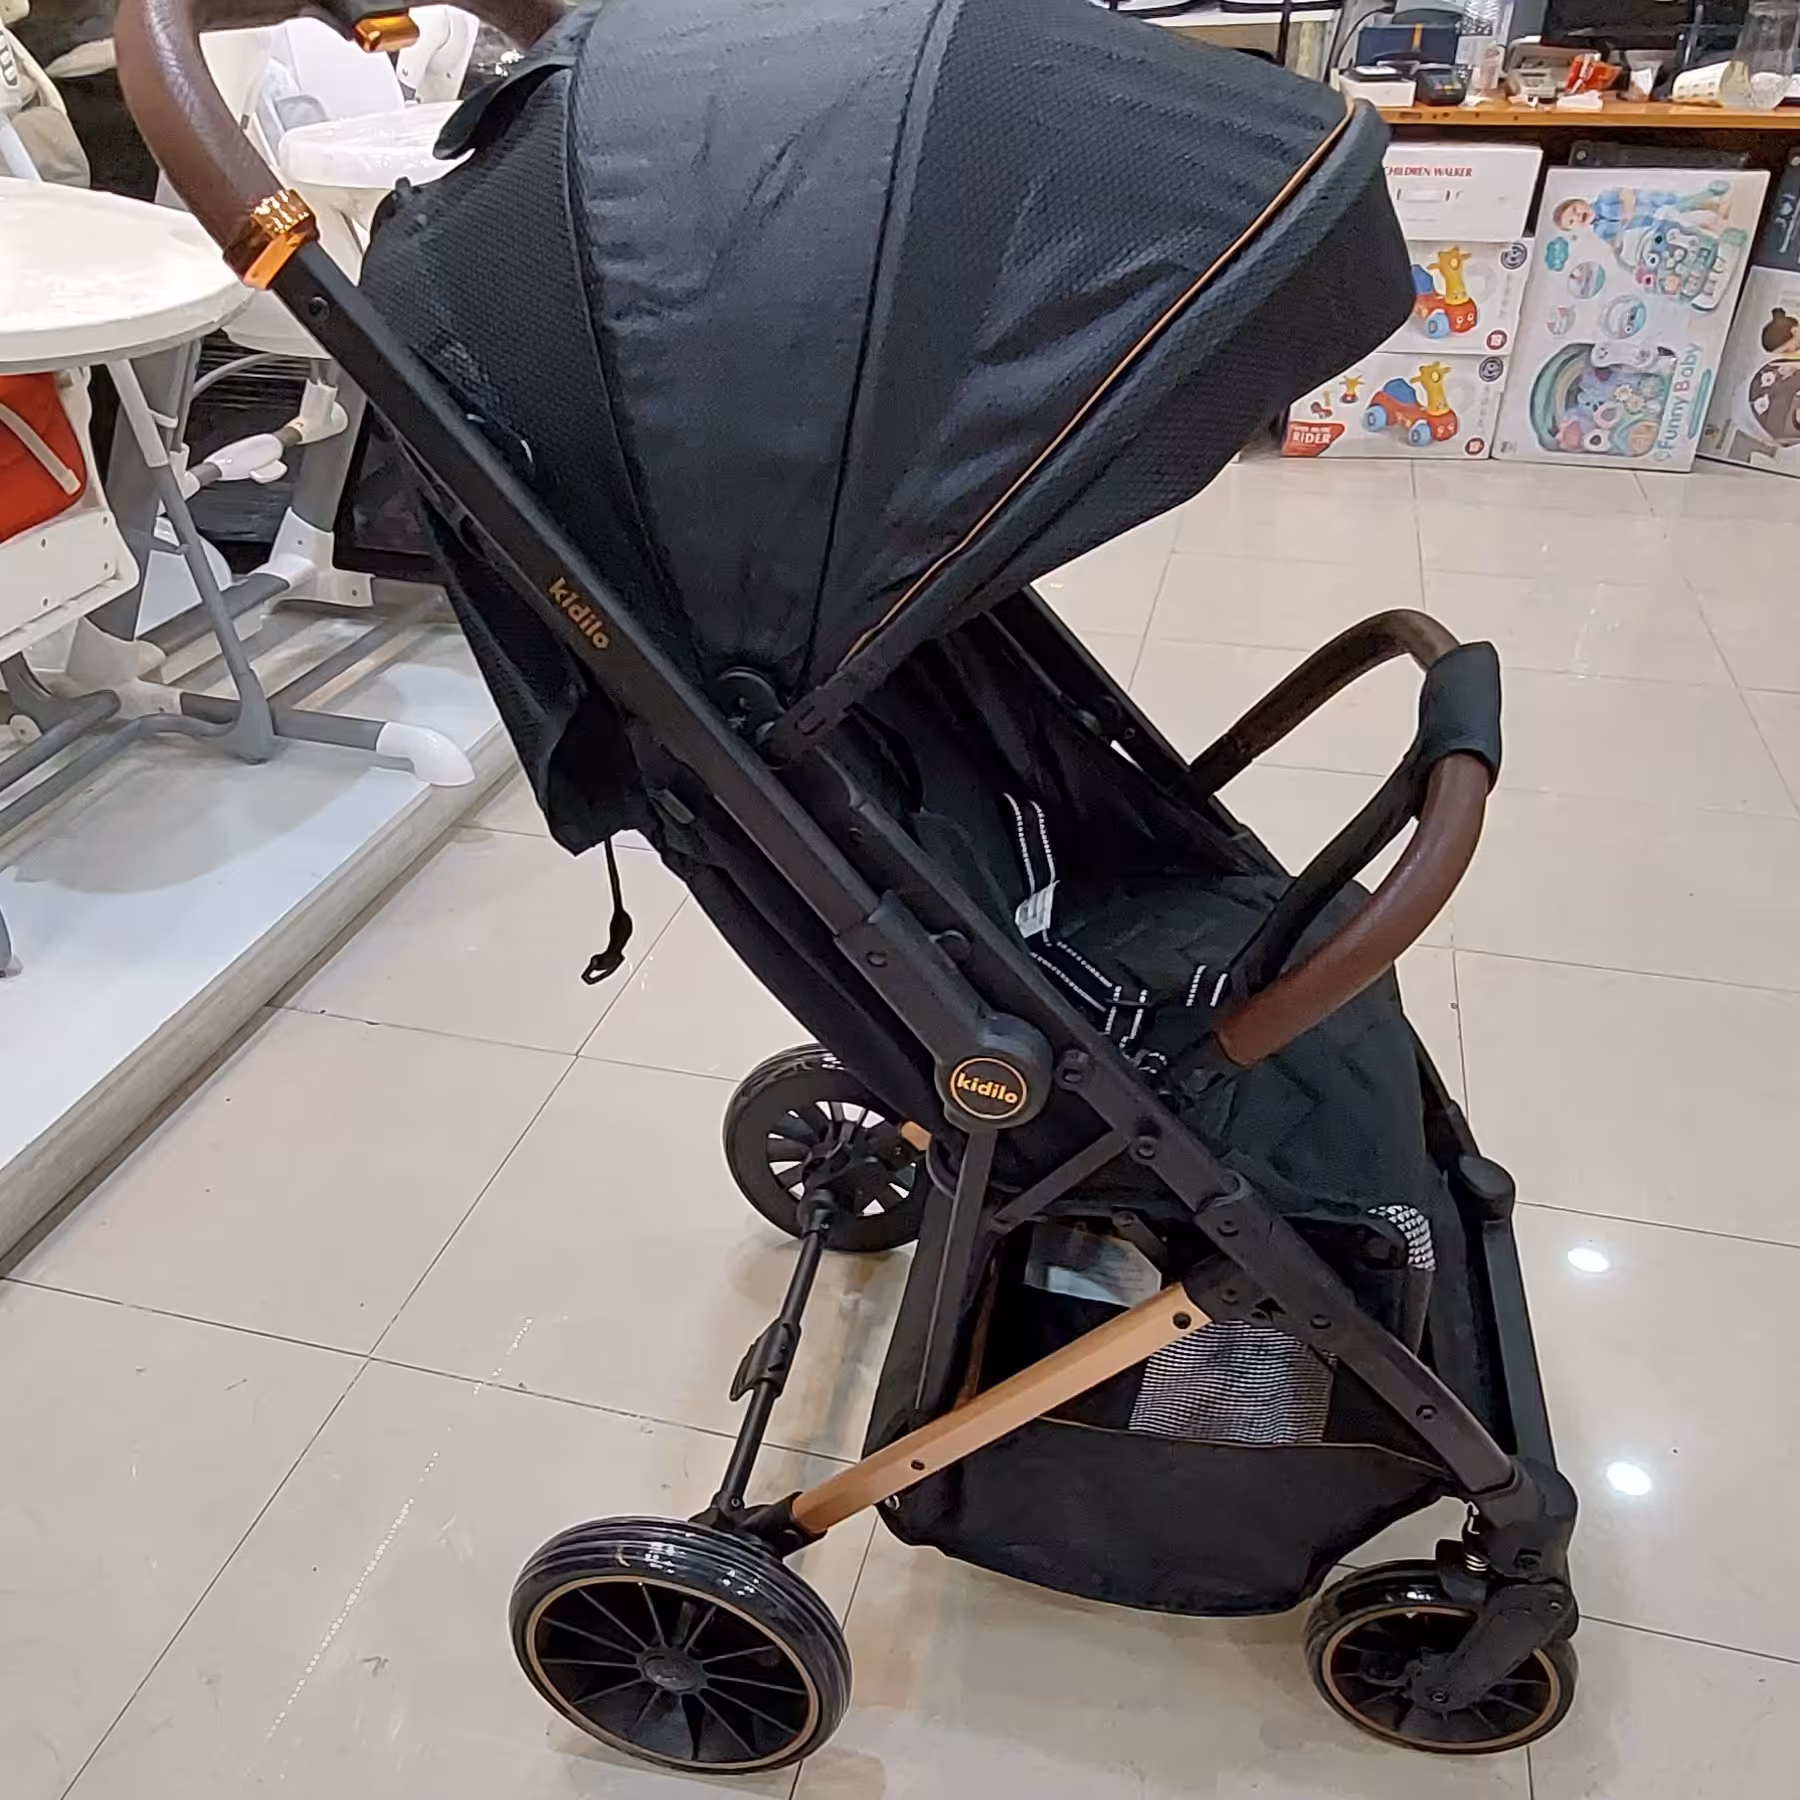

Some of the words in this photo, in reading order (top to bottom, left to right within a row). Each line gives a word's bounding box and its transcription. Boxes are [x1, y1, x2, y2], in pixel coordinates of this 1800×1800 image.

[1433, 167, 1473, 177] WALKER
[1656, 395, 1690, 450] Funny
[1673, 342, 1703, 393] Baby
[1292, 431, 1331, 445] RIDER
[548, 576, 609, 649] kidilo
[957, 1072, 1019, 1104] kidilo
